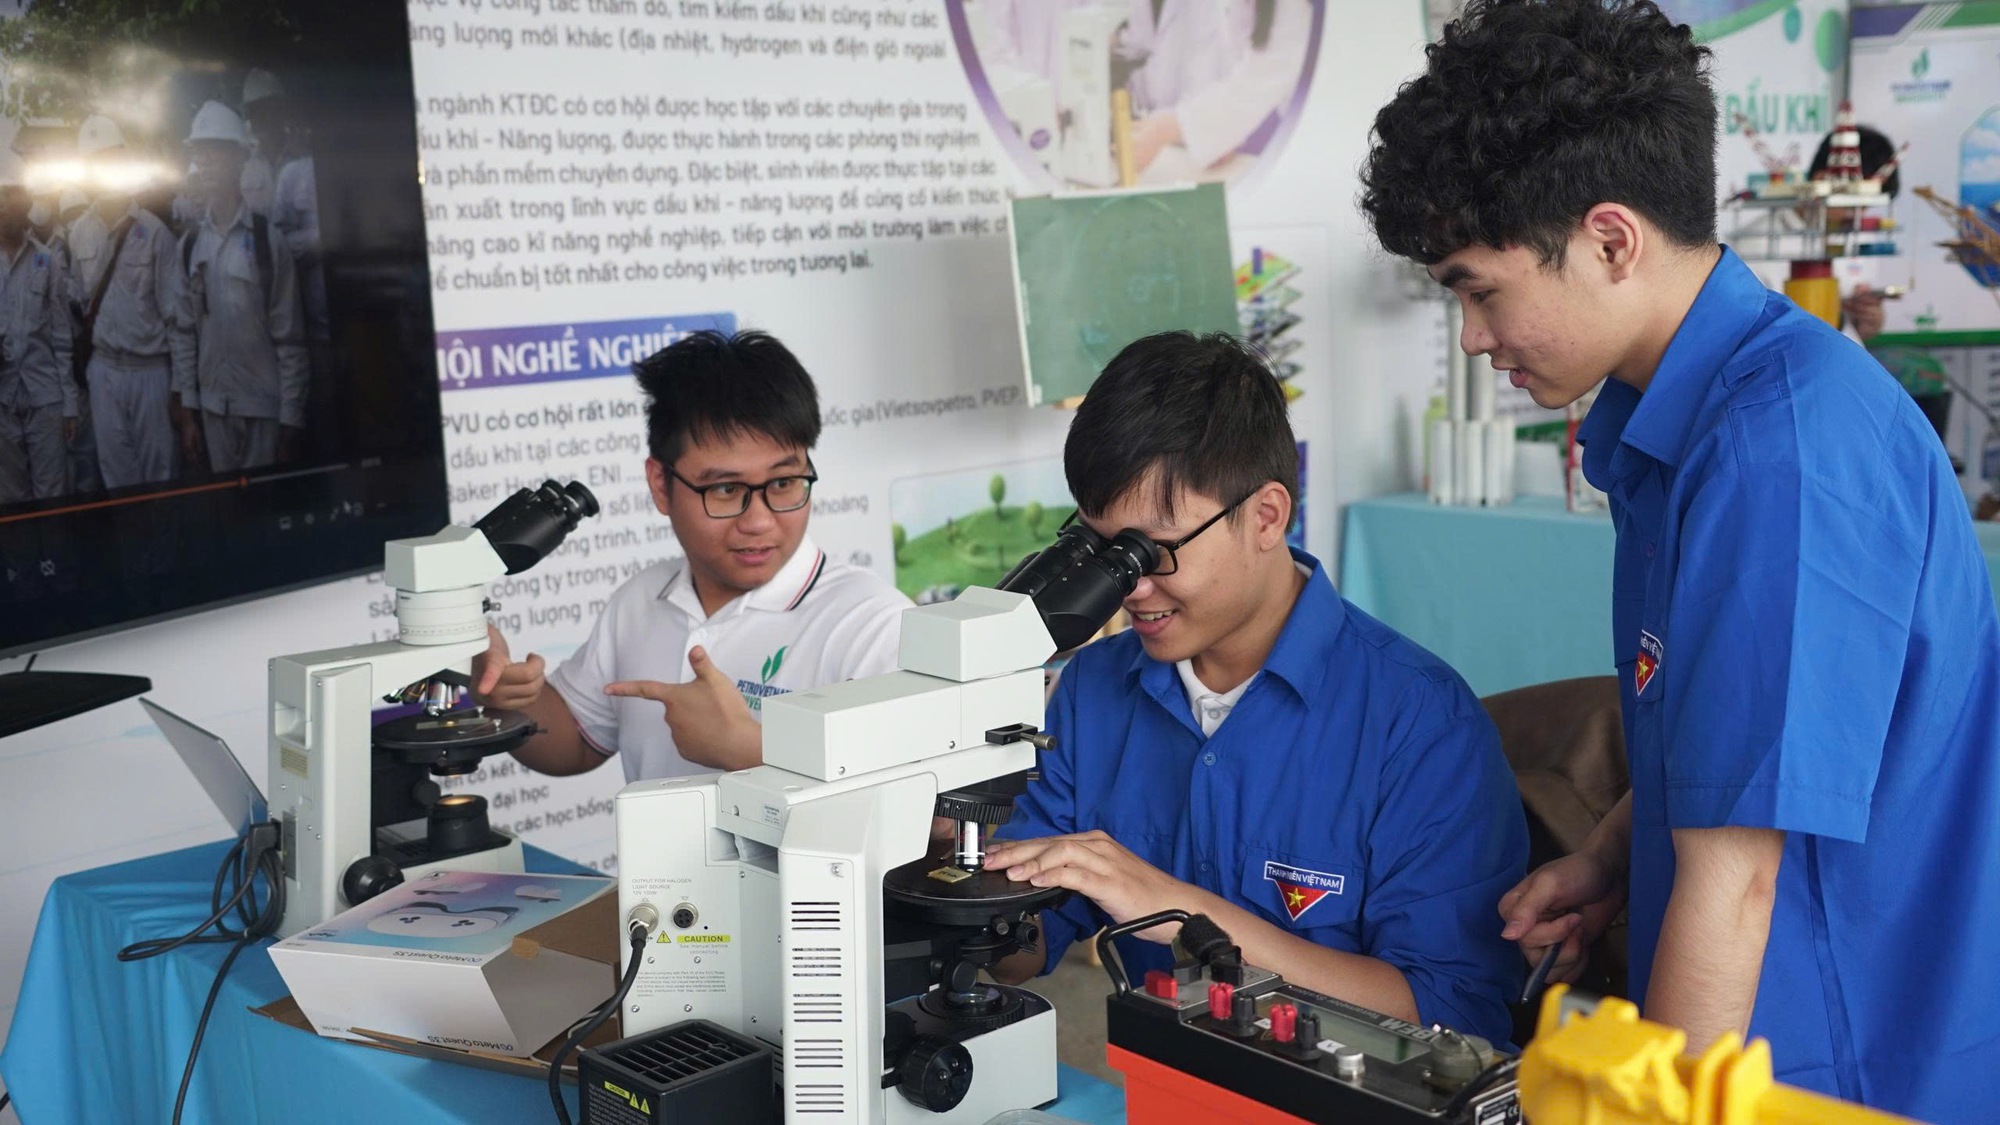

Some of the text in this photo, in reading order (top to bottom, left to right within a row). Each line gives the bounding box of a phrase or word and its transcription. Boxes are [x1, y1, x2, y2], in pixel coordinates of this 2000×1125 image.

[831, 6, 872, 28] cũng
[876, 8, 907, 28] như
[911, 9, 938, 29] các
[454, 22, 513, 50] lượng
[521, 26, 558, 47] mới
[566, 26, 614, 50] khác
[722, 33, 802, 59] hydrogen
[807, 35, 828, 54] và
[833, 36, 869, 60] điện
[874, 38, 899, 61] gió
[904, 39, 947, 61] ngoài
[429, 96, 495, 120] ngành
[500, 95, 558, 117] KTĐC
[563, 97, 588, 117] có
[593, 98, 617, 117] cơ
[621, 96, 650, 122] hội
[655, 97, 701, 122] được
[705, 97, 738, 123] học
[743, 98, 771, 123] tập
[775, 98, 800, 119] với
[804, 99, 833, 119] các
[837, 100, 895, 123] chuyên
[899, 100, 922, 123] gia
[926, 101, 967, 123] trong
[1726, 75, 1781, 134] DẦU
[500, 130, 552, 154] Năng
[622, 131, 669, 154] được
[673, 131, 714, 154] thực
[718, 131, 761, 150] hành
[765, 132, 811, 152] trong
[815, 132, 845, 150] các
[849, 132, 899, 152] phòng
[925, 132, 980, 153] nghiệm
[559, 164, 629, 189] chuyên
[688, 160, 722, 184] Đặc
[768, 161, 802, 180] sinh
[805, 162, 839, 180] viên
[842, 160, 881, 181] được
[883, 160, 920, 180] thực
[922, 160, 947, 180] tập
[950, 159, 969, 178] tại
[971, 158, 997, 177] các
[456, 196, 503, 221] xuất
[511, 200, 564, 223] trong
[572, 196, 606, 218] lĩnh
[615, 198, 647, 220] vực
[740, 194, 782, 216] năng
[788, 192, 834, 214] lượng
[933, 187, 963, 207] kiến
[968, 187, 1000, 206] thức
[483, 235, 520, 253] cao
[552, 230, 600, 254] năng
[733, 221, 766, 246] tiếp
[772, 222, 803, 243] cận
[810, 222, 831, 241] với
[838, 220, 866, 240] môi
[872, 218, 923, 241] trường
[928, 217, 955, 236] làm
[961, 214, 989, 238] việc
[453, 265, 517, 291] chuẩn
[521, 266, 539, 292] bị
[545, 263, 572, 286] tốt
[577, 260, 619, 284] nhất
[625, 260, 659, 282] cho
[663, 259, 707, 282] công
[712, 258, 746, 283] việc
[751, 256, 796, 278] trong
[800, 252, 847, 275] tương
[851, 250, 873, 270] lai.
[492, 325, 581, 377] NGHỀ
[486, 410, 510, 431] có
[515, 408, 539, 427] cơ
[544, 402, 573, 428] hội
[578, 399, 605, 422] rất
[609, 398, 637, 418] lớn
[852, 407, 875, 428] gia
[527, 436, 550, 462] tại
[556, 434, 589, 456] các
[594, 431, 641, 455] công
[588, 465, 622, 485] ENI
[609, 491, 631, 515] số
[492, 575, 540, 601] công
[543, 572, 564, 594] ty
[567, 565, 616, 590] trong
[528, 599, 582, 626] lượng
[490, 760, 515, 779] kết
[492, 784, 550, 811] đại học
[513, 814, 543, 834] các
[545, 807, 574, 828] học
[1302, 873, 1320, 886] VIỆT
[1320, 878, 1340, 888] NAM
[684, 935, 724, 943] CAUTION
[409, 952, 440, 960] Quest
[441, 1036, 472, 1047] Quest
[473, 1040, 500, 1050] Meta
